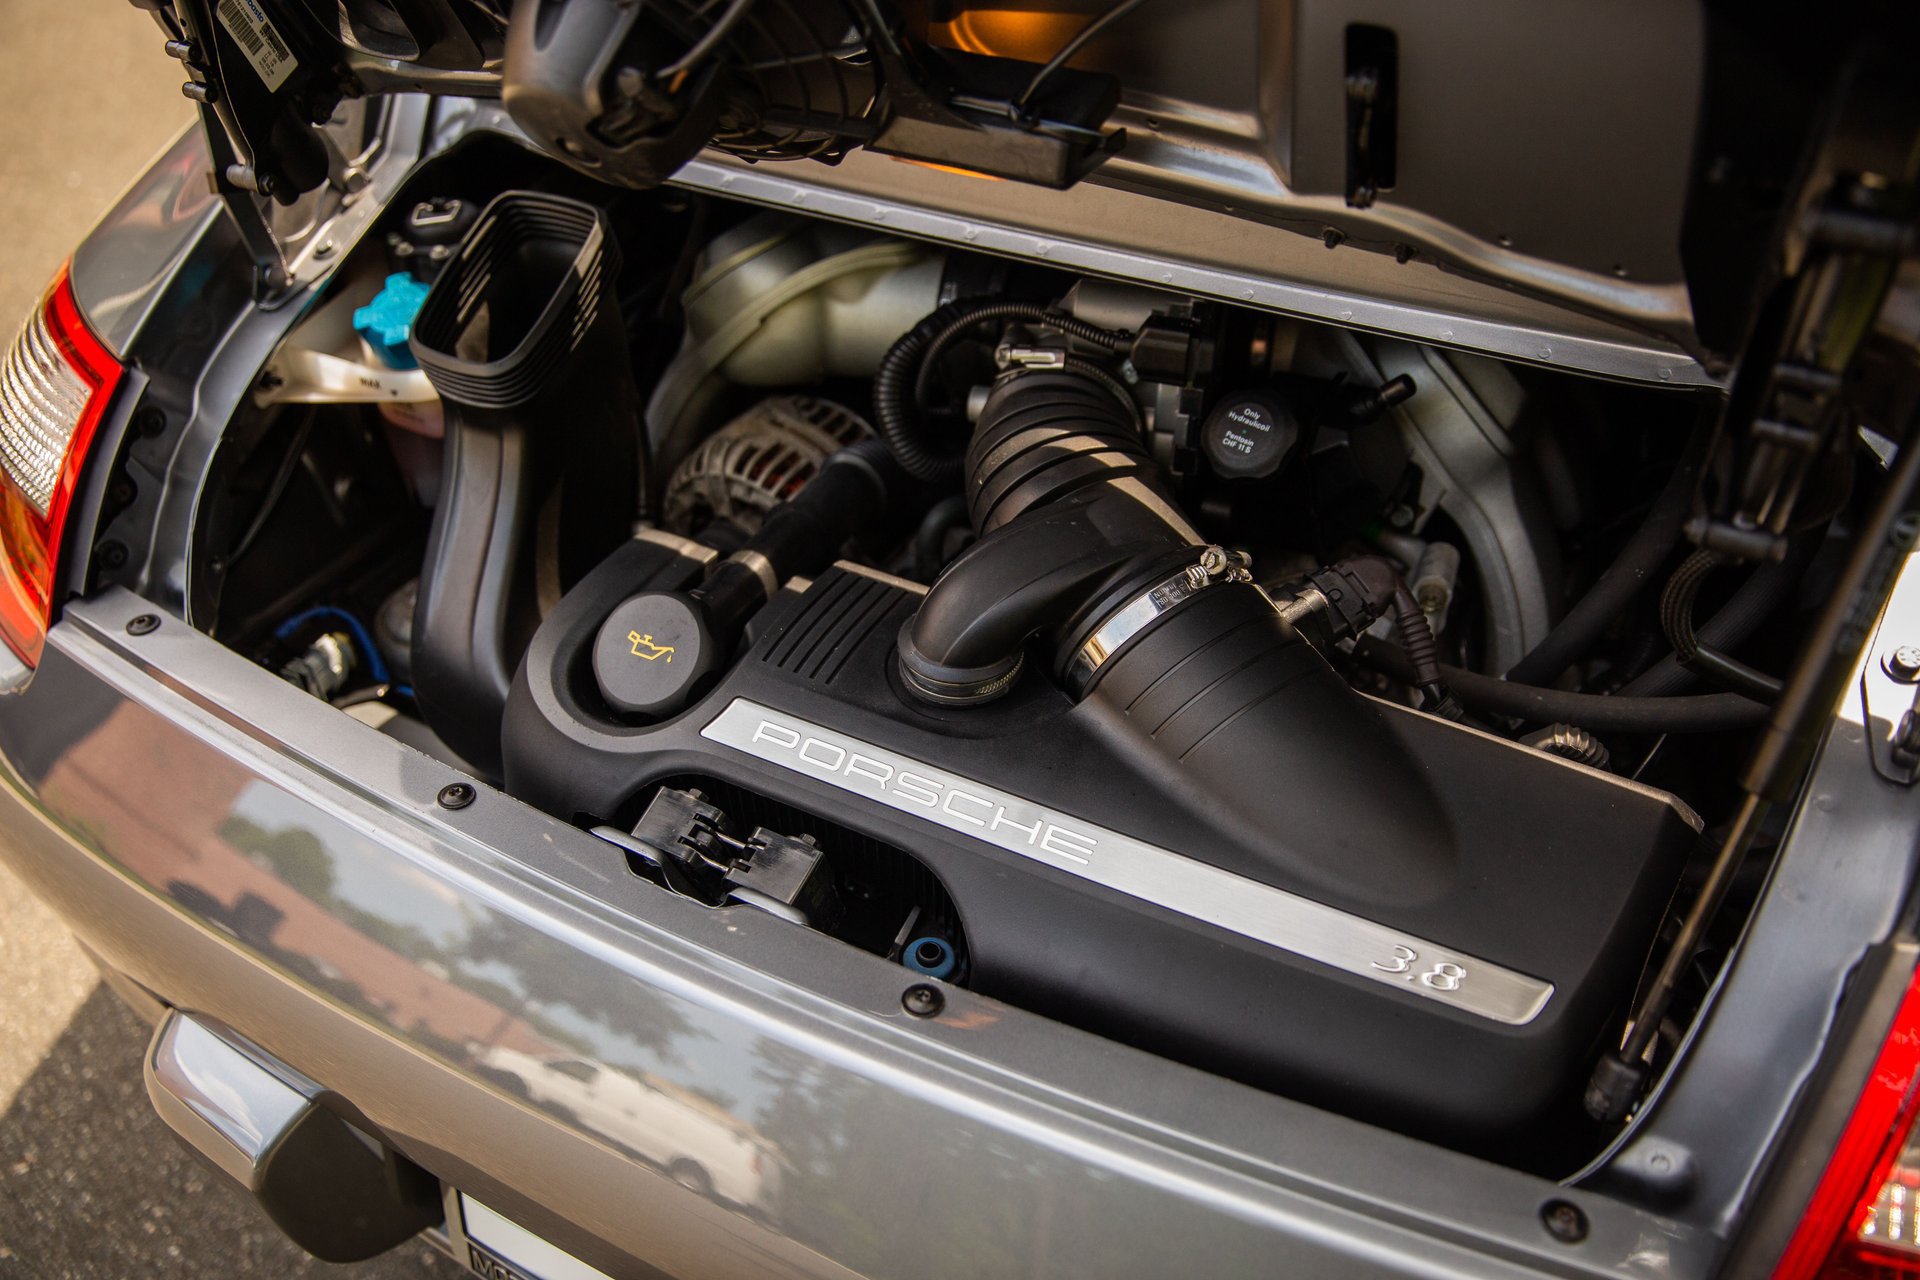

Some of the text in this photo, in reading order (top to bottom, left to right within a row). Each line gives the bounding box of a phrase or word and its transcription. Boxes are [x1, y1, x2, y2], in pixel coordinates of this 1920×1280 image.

[1228, 411, 1271, 432] Hydraulicoil
[1244, 408, 1261, 420] Only
[1222, 438, 1238, 448] CHF
[1225, 430, 1255, 447] Pentosin
[752, 719, 1099, 866] PORSCHE
[1370, 944, 1467, 992] 3.8
